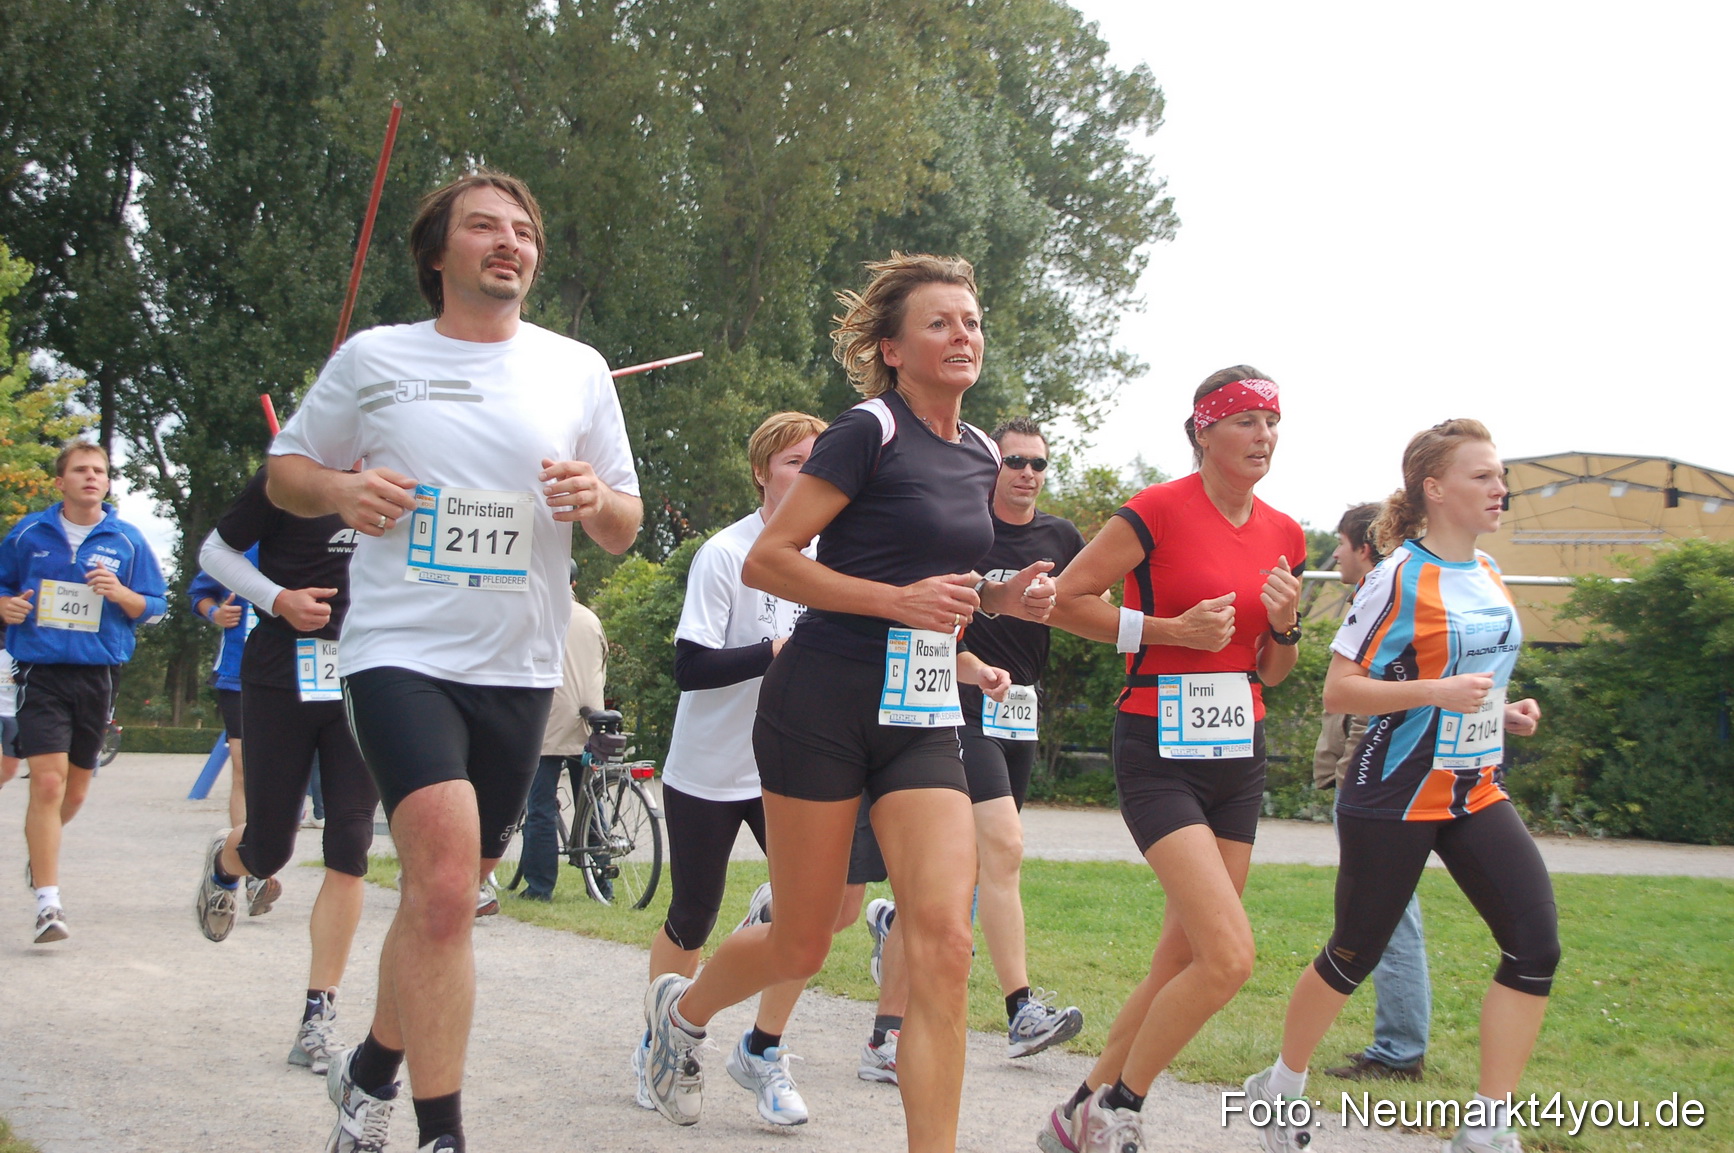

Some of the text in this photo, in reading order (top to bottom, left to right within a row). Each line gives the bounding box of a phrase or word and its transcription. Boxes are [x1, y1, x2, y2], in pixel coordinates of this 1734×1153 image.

[447, 497, 514, 518] Christian
[420, 521, 427, 534] D
[446, 527, 519, 555] 2117
[483, 575, 527, 585] PFLEIDERER
[57, 586, 79, 597] Chris
[61, 602, 89, 616] 401
[322, 644, 337, 656] Kla
[324, 663, 335, 680] 2
[892, 664, 899, 678] C
[914, 668, 951, 692] 3270
[1189, 682, 1214, 697] Irmi
[1002, 705, 1031, 720] 2102
[1166, 706, 1172, 717] C
[1191, 706, 1245, 728] 3246
[1446, 721, 1453, 732] D
[1465, 717, 1498, 742] 2104
